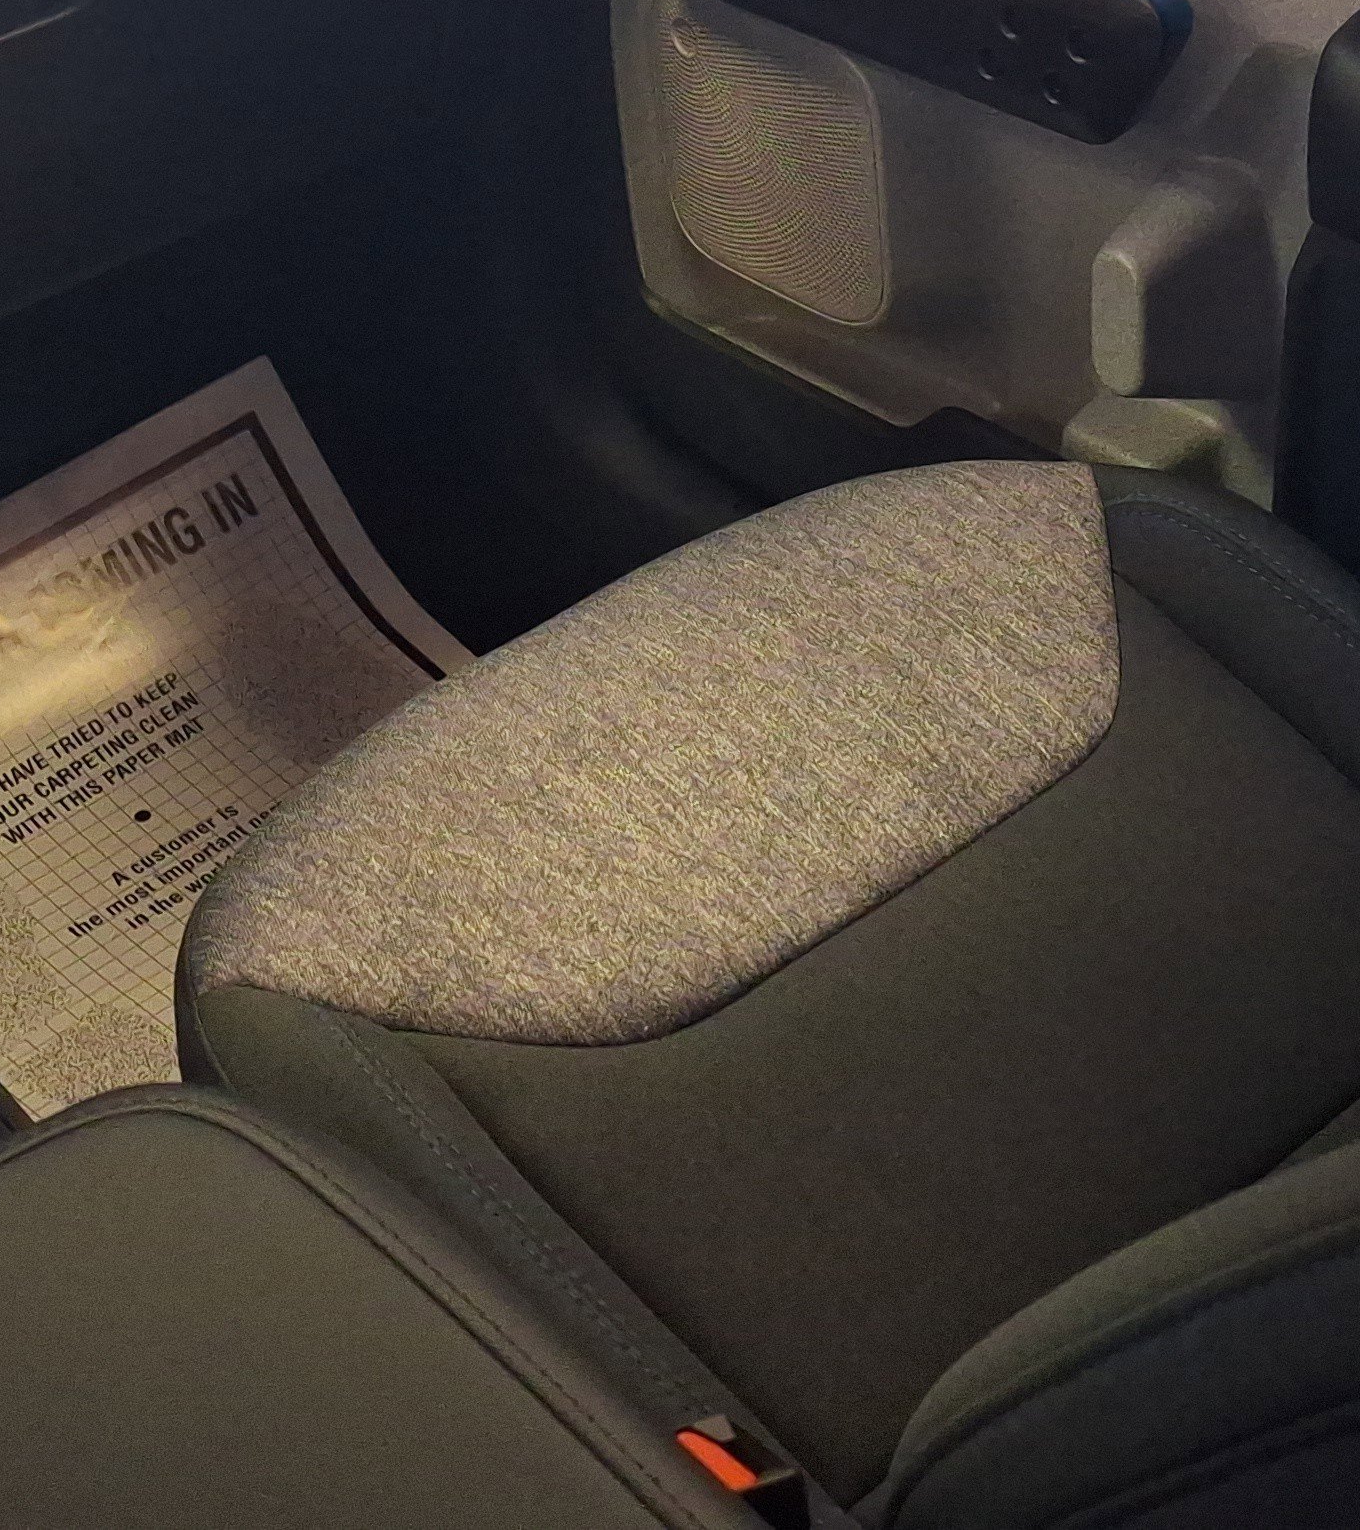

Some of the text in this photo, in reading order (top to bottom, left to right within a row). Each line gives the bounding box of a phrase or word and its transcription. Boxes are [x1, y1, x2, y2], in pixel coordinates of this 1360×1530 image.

[201, 473, 260, 534] IN
[33, 728, 140, 800] CARPETING
[139, 691, 201, 736] CLEAN
[45, 718, 107, 760] TRIED
[104, 700, 134, 726] TO
[132, 671, 179, 710] KEEP
[0, 716, 207, 847] WITH THIS PAPER MAT
[68, 824, 251, 938] the most important
[111, 869, 131, 888] A
[130, 816, 219, 875] customer
[215, 804, 240, 821] is
[124, 913, 150, 930] in
[147, 891, 185, 916] the
